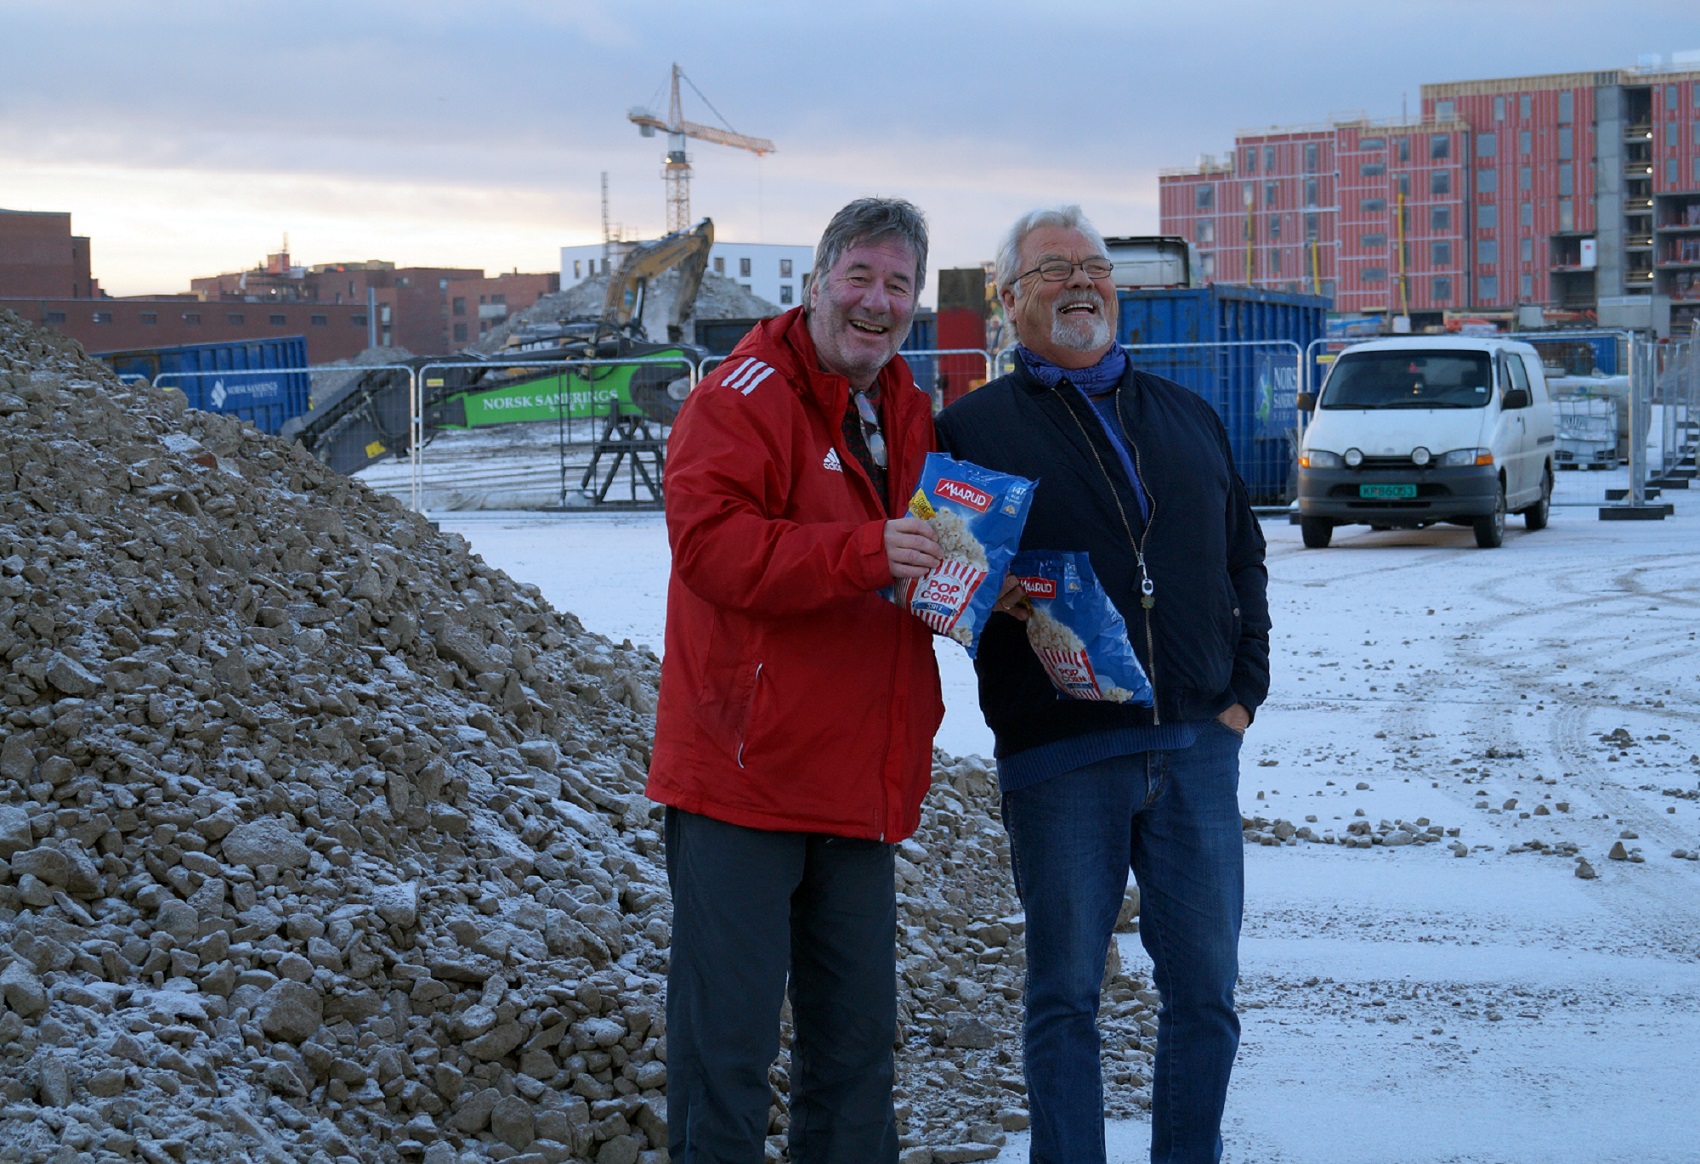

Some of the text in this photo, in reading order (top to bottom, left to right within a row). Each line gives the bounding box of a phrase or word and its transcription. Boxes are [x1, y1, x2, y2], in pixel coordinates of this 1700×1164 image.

[1274, 367, 1297, 390] NORS
[483, 396, 533, 410] NORSK
[938, 482, 987, 506] MAARUD
[928, 579, 960, 595] POP
[921, 590, 959, 605] CORN
[1058, 668, 1079, 677] POP
[1062, 675, 1087, 683] CORN
